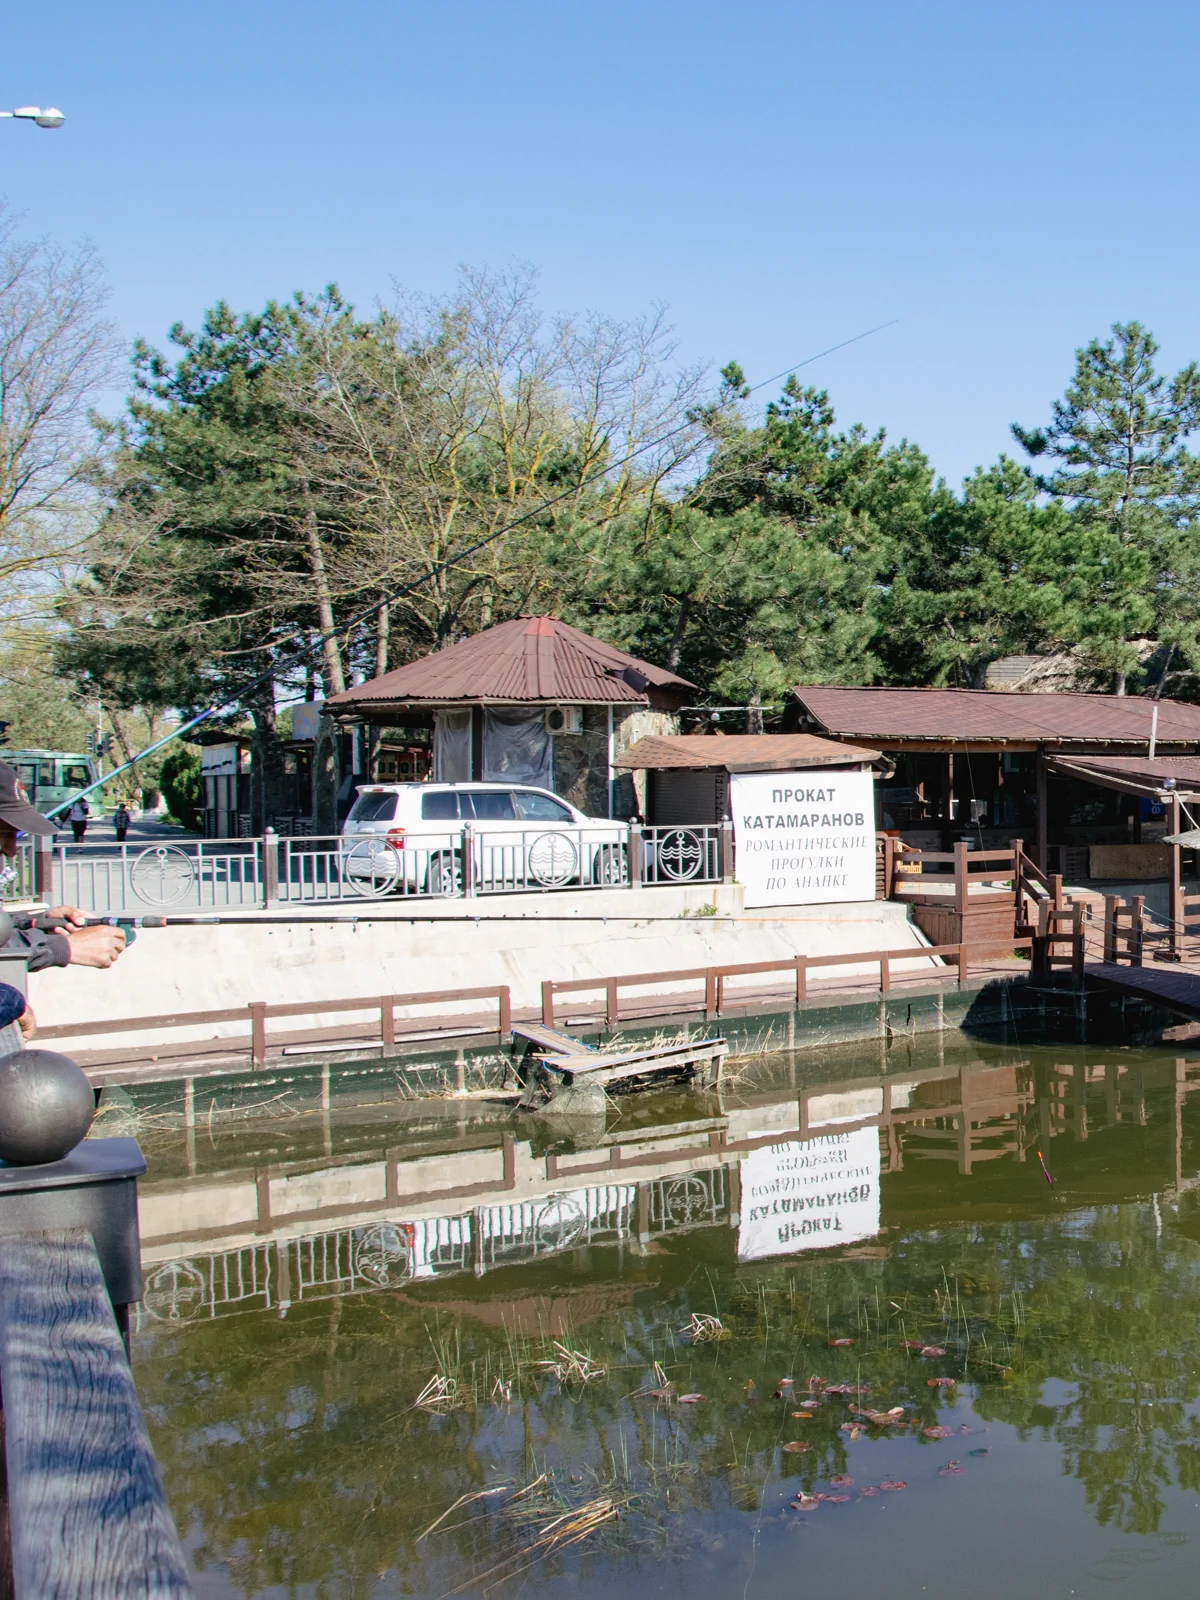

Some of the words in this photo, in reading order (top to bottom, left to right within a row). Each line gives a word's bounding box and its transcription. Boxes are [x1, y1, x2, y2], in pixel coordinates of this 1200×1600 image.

[772, 788, 836, 803] ПРОКАТ
[743, 812, 865, 829] КАТАМАРАНОВ
[745, 836, 868, 852] РОМАНТИЧЕСКИЕ
[771, 856, 844, 870] ПРОГУЛКИ
[765, 877, 787, 890] ПО
[792, 874, 849, 889] АНАПКЕ
